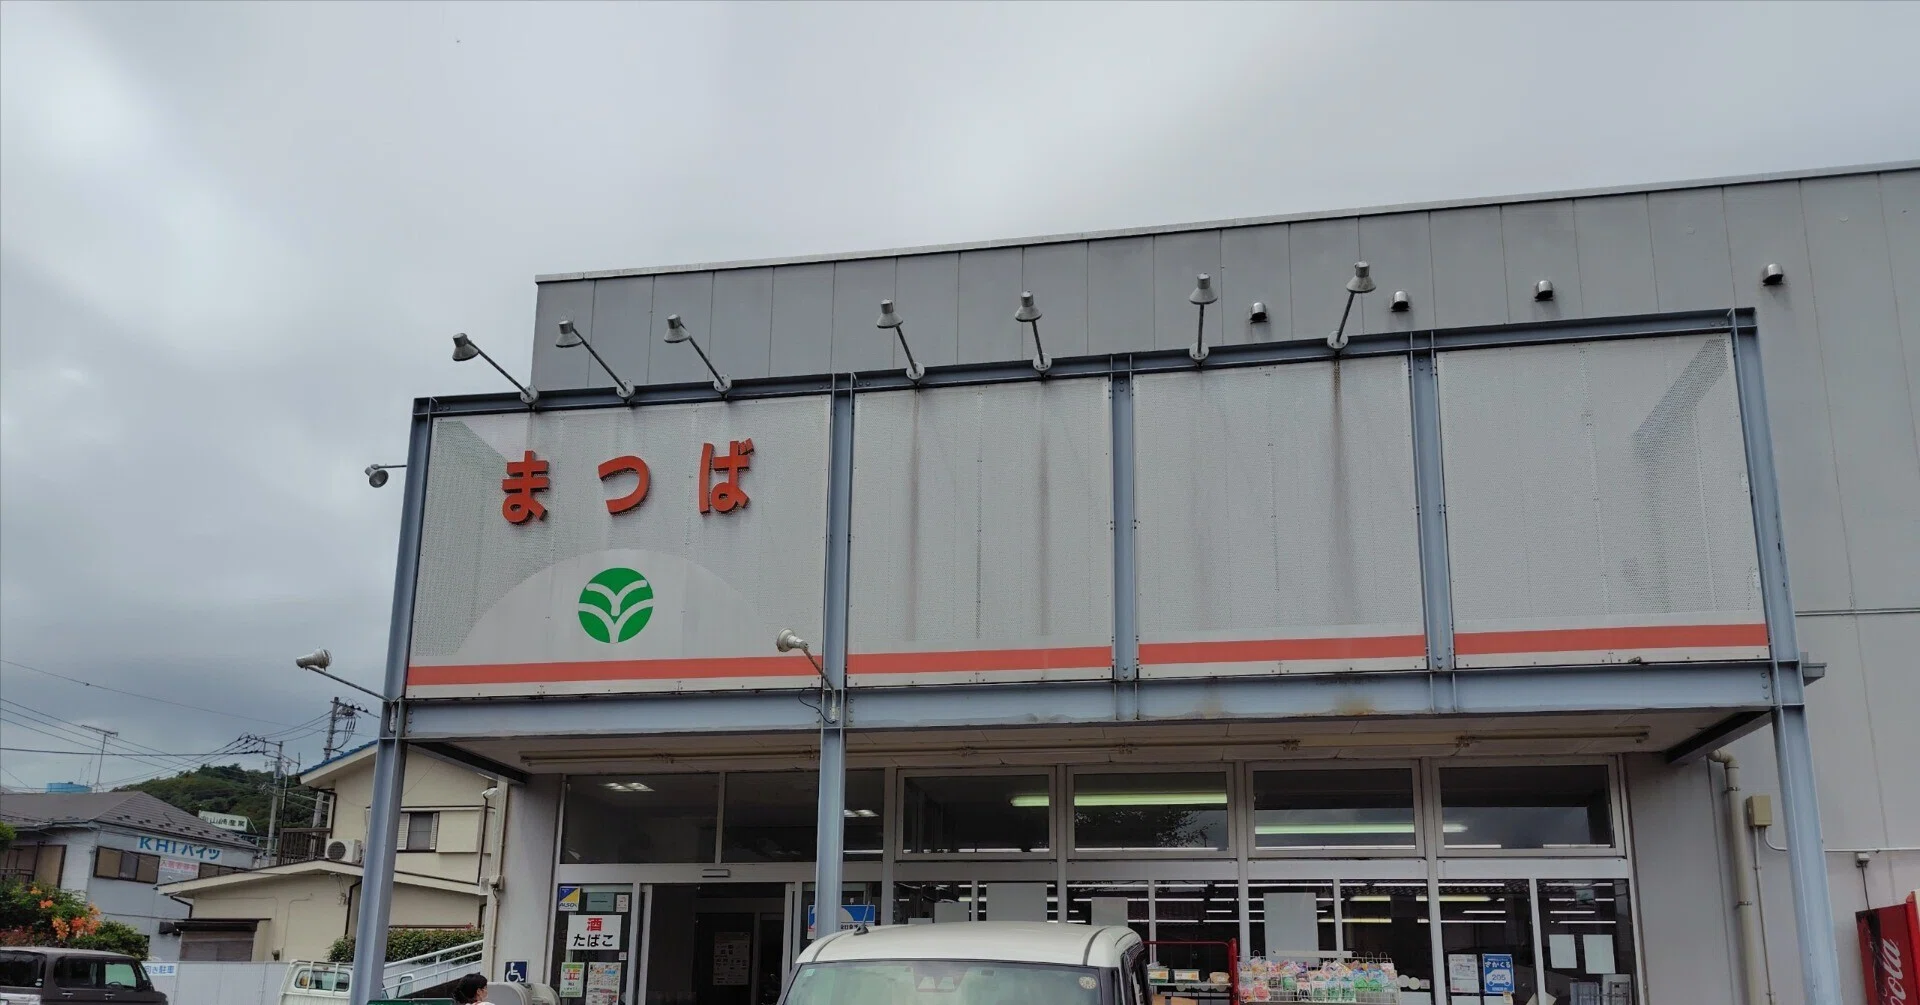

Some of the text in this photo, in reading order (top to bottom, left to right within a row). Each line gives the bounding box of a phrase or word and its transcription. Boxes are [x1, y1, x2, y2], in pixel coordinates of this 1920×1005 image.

[502, 438, 755, 523] まつば
[573, 933, 614, 948] たばこ
[587, 917, 603, 932] 酒
[1881, 938, 1907, 1005] ola
